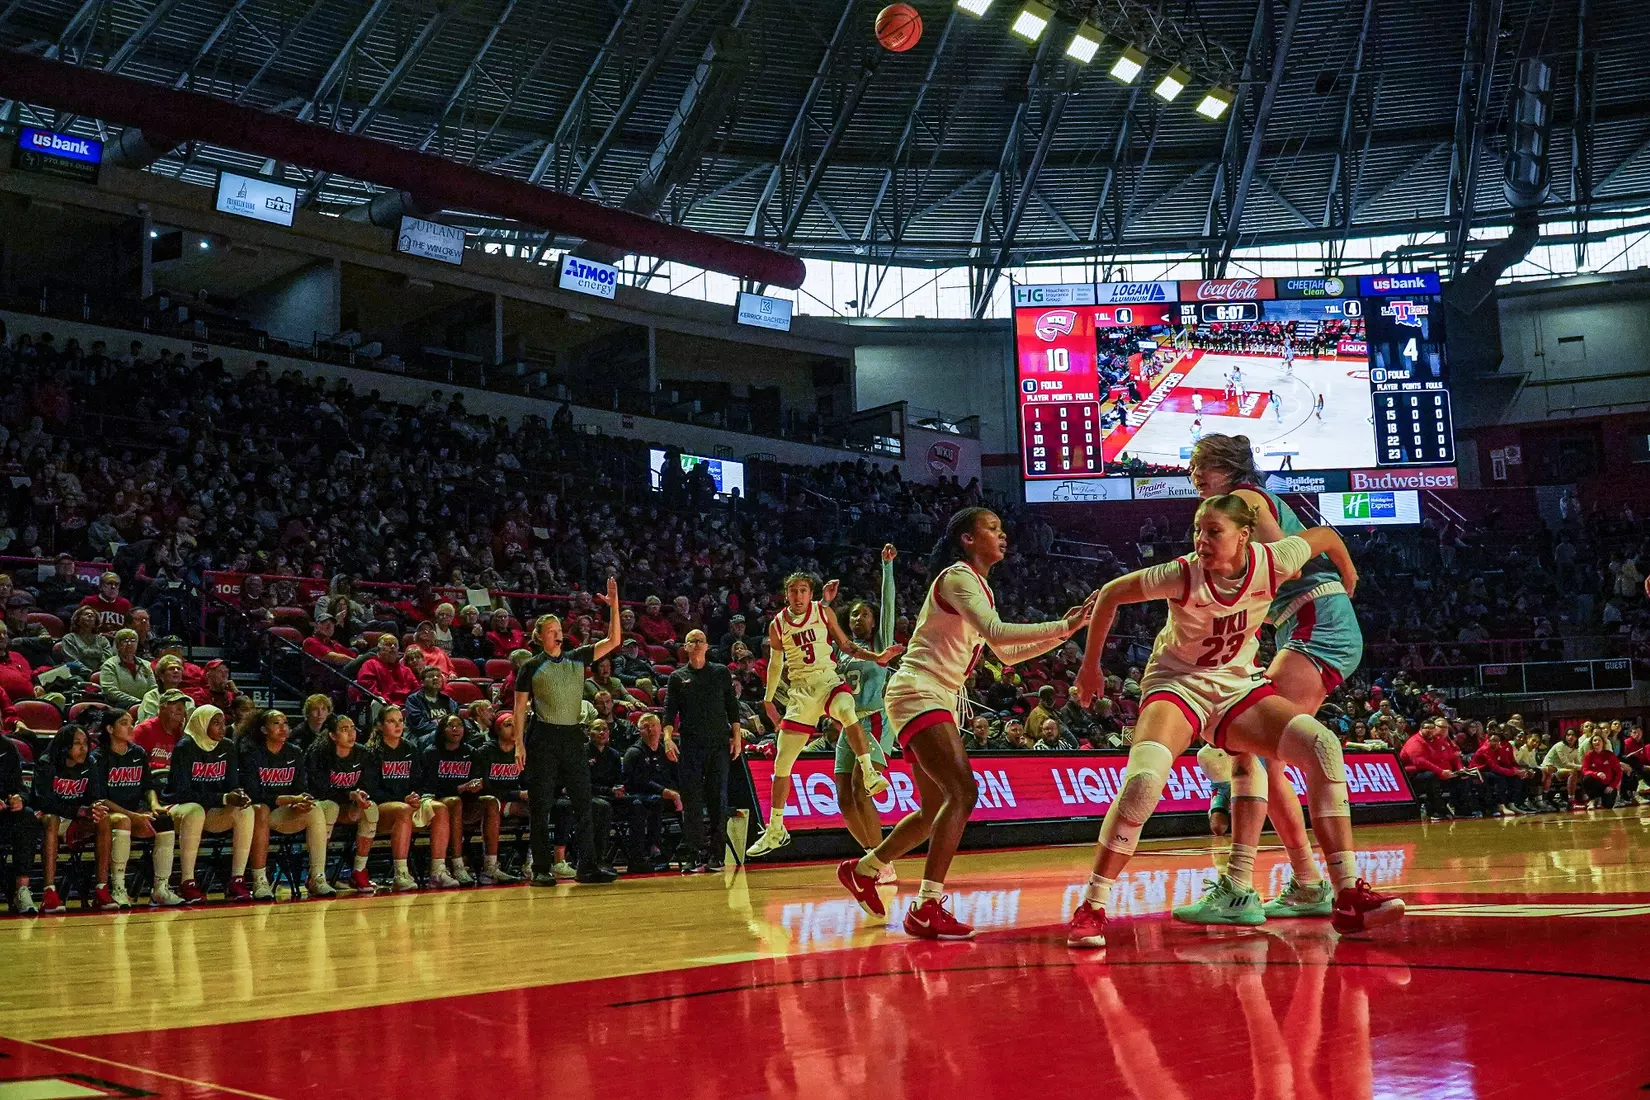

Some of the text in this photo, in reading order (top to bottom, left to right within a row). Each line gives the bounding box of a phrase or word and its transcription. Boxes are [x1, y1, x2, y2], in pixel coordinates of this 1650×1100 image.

[266, 199, 291, 212] ETR
[417, 221, 465, 240] UPLAND
[412, 239, 425, 250] THE
[565, 260, 615, 285] ATMOS
[578, 278, 614, 295] energy
[1112, 284, 1150, 296] LOGAN
[1288, 279, 1325, 290] CHEETAH
[1303, 288, 1325, 296] Clean
[1181, 305, 1195, 315] 1ST
[1216, 306, 1244, 320] 6:07
[1348, 303, 1357, 315] 4
[740, 312, 762, 320] KERRICK
[1120, 309, 1128, 322] 4
[1403, 338, 1418, 361] 4
[1046, 348, 1069, 372] 10
[1388, 370, 1410, 379] FOULS
[1040, 381, 1063, 390] FOULS
[1052, 393, 1072, 401] POINTS
[1075, 392, 1093, 400] FOULS
[1387, 396, 1441, 407] 3 0 0
[1035, 407, 1091, 418] 1 0 0
[1386, 409, 1442, 420] 15 0 0
[1035, 420, 1092, 432] 3 0 0
[1387, 422, 1443, 433] 18 0 0
[1034, 433, 1092, 445] 10 0 0
[1387, 434, 1445, 446] 22 0 0
[1033, 445, 1093, 457] 23 0 0
[1388, 448, 1446, 459] 23 0 0
[1034, 459, 1094, 471] 33 0 0
[1286, 476, 1325, 486] Builders
[1353, 471, 1456, 490] Budweiser
[1136, 482, 1166, 494] Prairie
[1168, 486, 1198, 496] Kentuc
[1293, 484, 1326, 493] Design
[1052, 494, 1107, 502] MOVERS
[216, 584, 241, 595] 105
[1213, 609, 1247, 636] WKU
[791, 628, 816, 646] WKU
[801, 643, 816, 664] 3
[1195, 633, 1246, 666] 23
[1605, 661, 1627, 670] GUEST
[151, 747, 172, 759] Hilltop
[192, 760, 226, 778] WKU
[382, 761, 412, 775] WKU
[438, 760, 472, 775] WKU
[490, 763, 521, 776] WKU
[108, 766, 143, 783] WKU
[259, 767, 295, 783] WKU
[329, 770, 361, 786] WKU
[1344, 763, 1400, 793] BARN
[53, 776, 88, 796] WKU
[1051, 761, 1212, 804] LIQU BAR
[771, 771, 921, 816] IQOR
